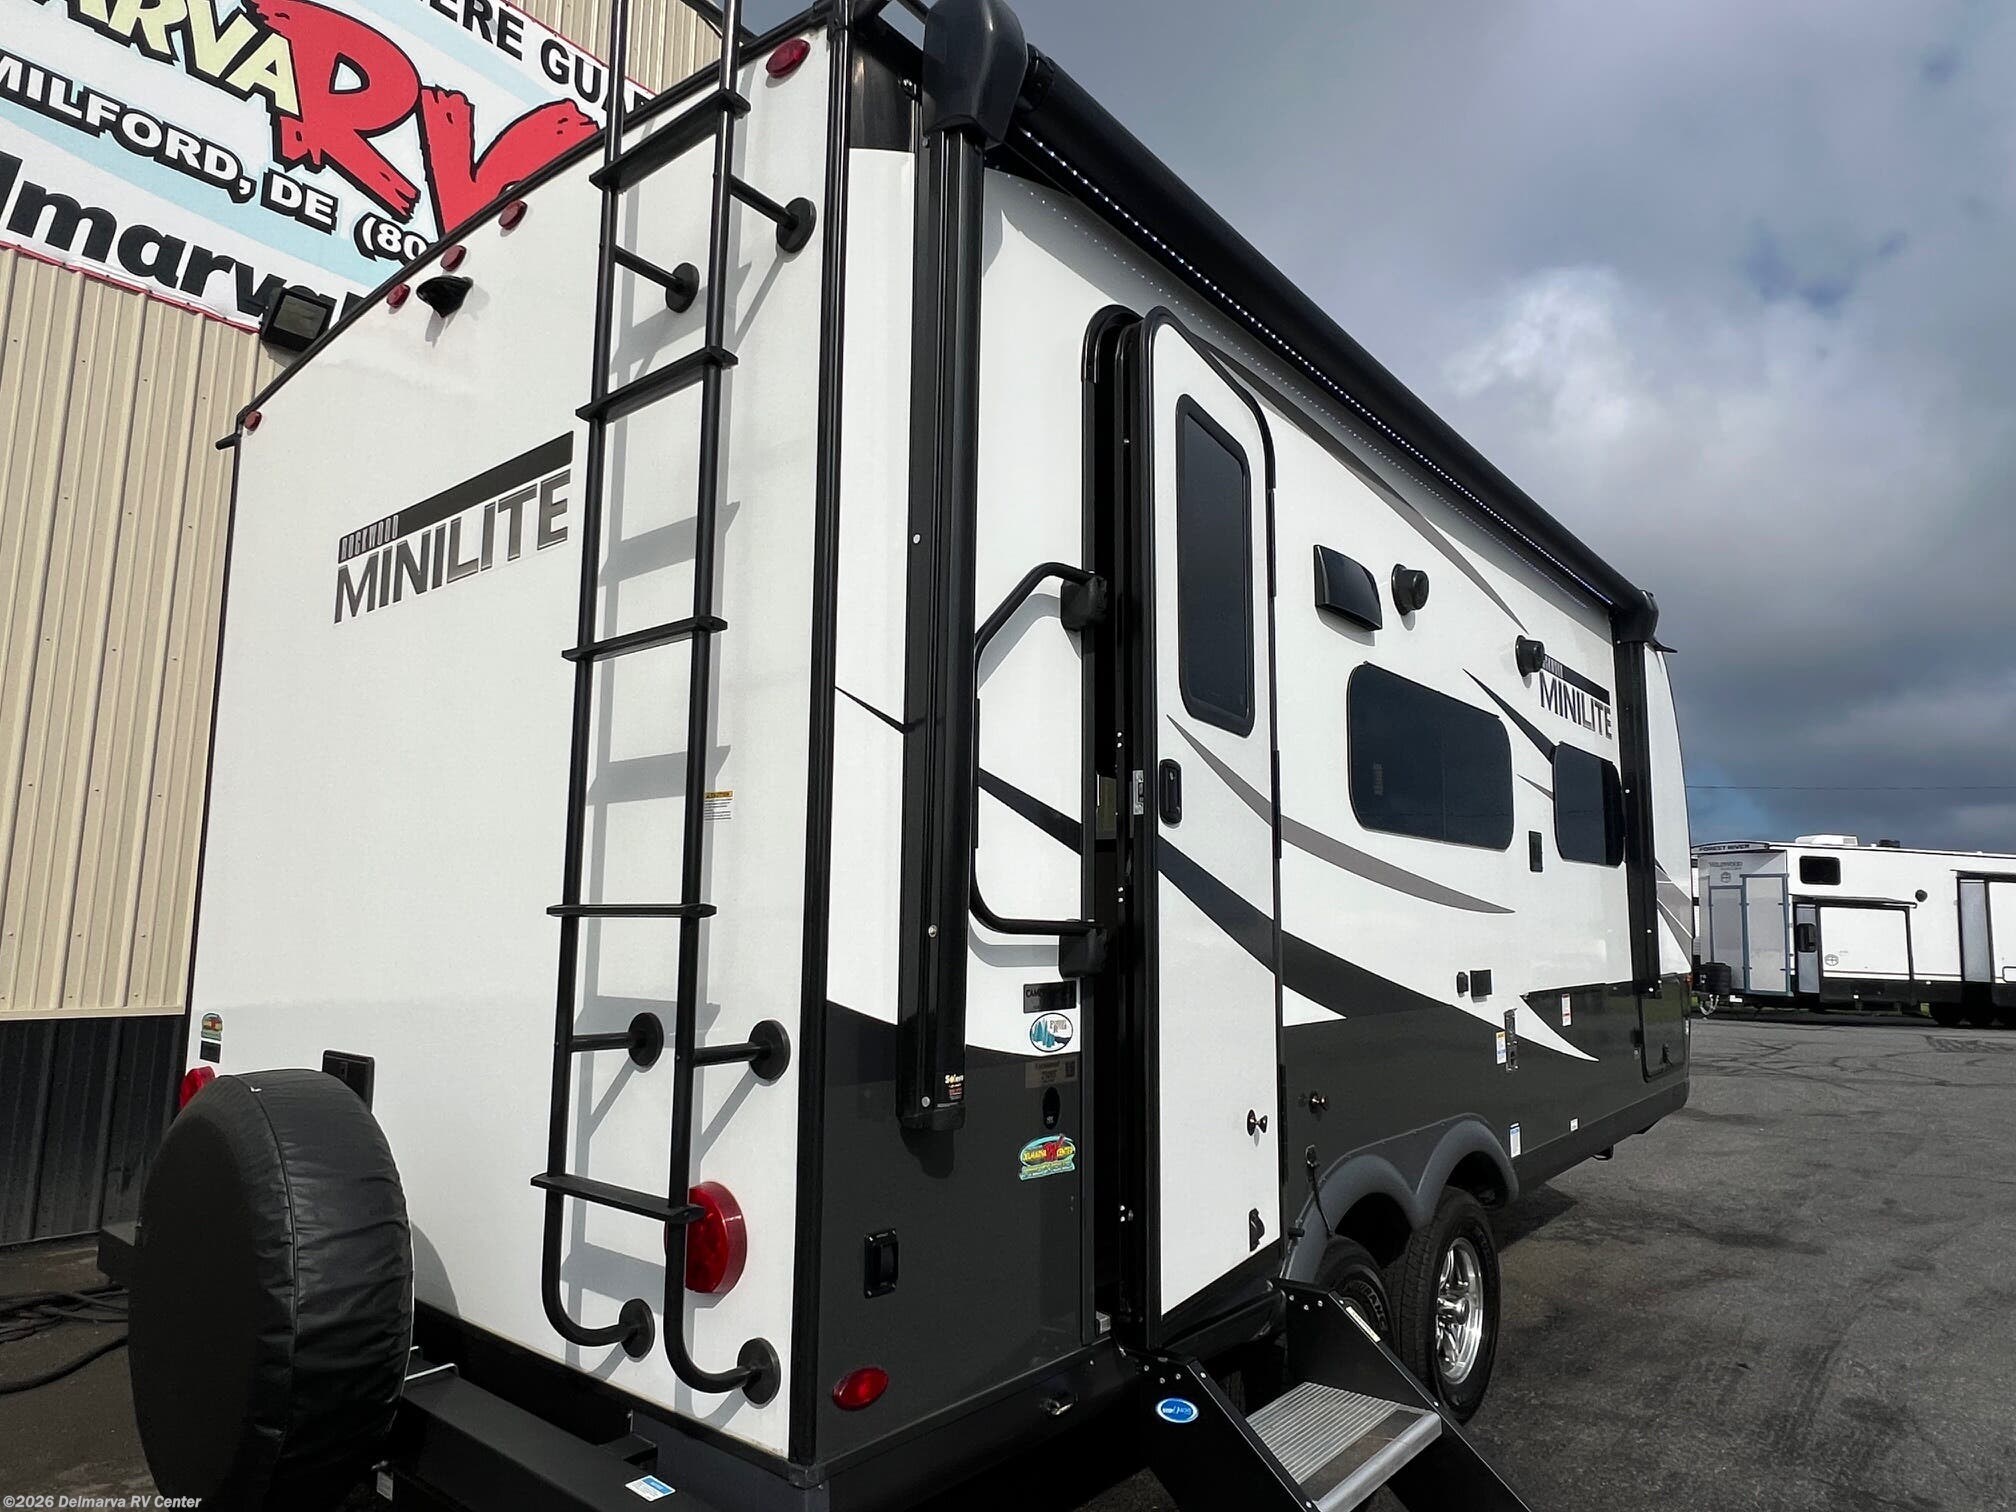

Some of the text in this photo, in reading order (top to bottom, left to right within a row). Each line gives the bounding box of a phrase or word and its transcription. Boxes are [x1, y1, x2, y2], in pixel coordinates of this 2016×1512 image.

[80, 0, 601, 233] RVA RV
[270, 175, 334, 226] DE
[334, 468, 571, 624] MINILITE
[341, 515, 399, 561] ROCKWOOD
[1540, 671, 1612, 740] MINILITE
